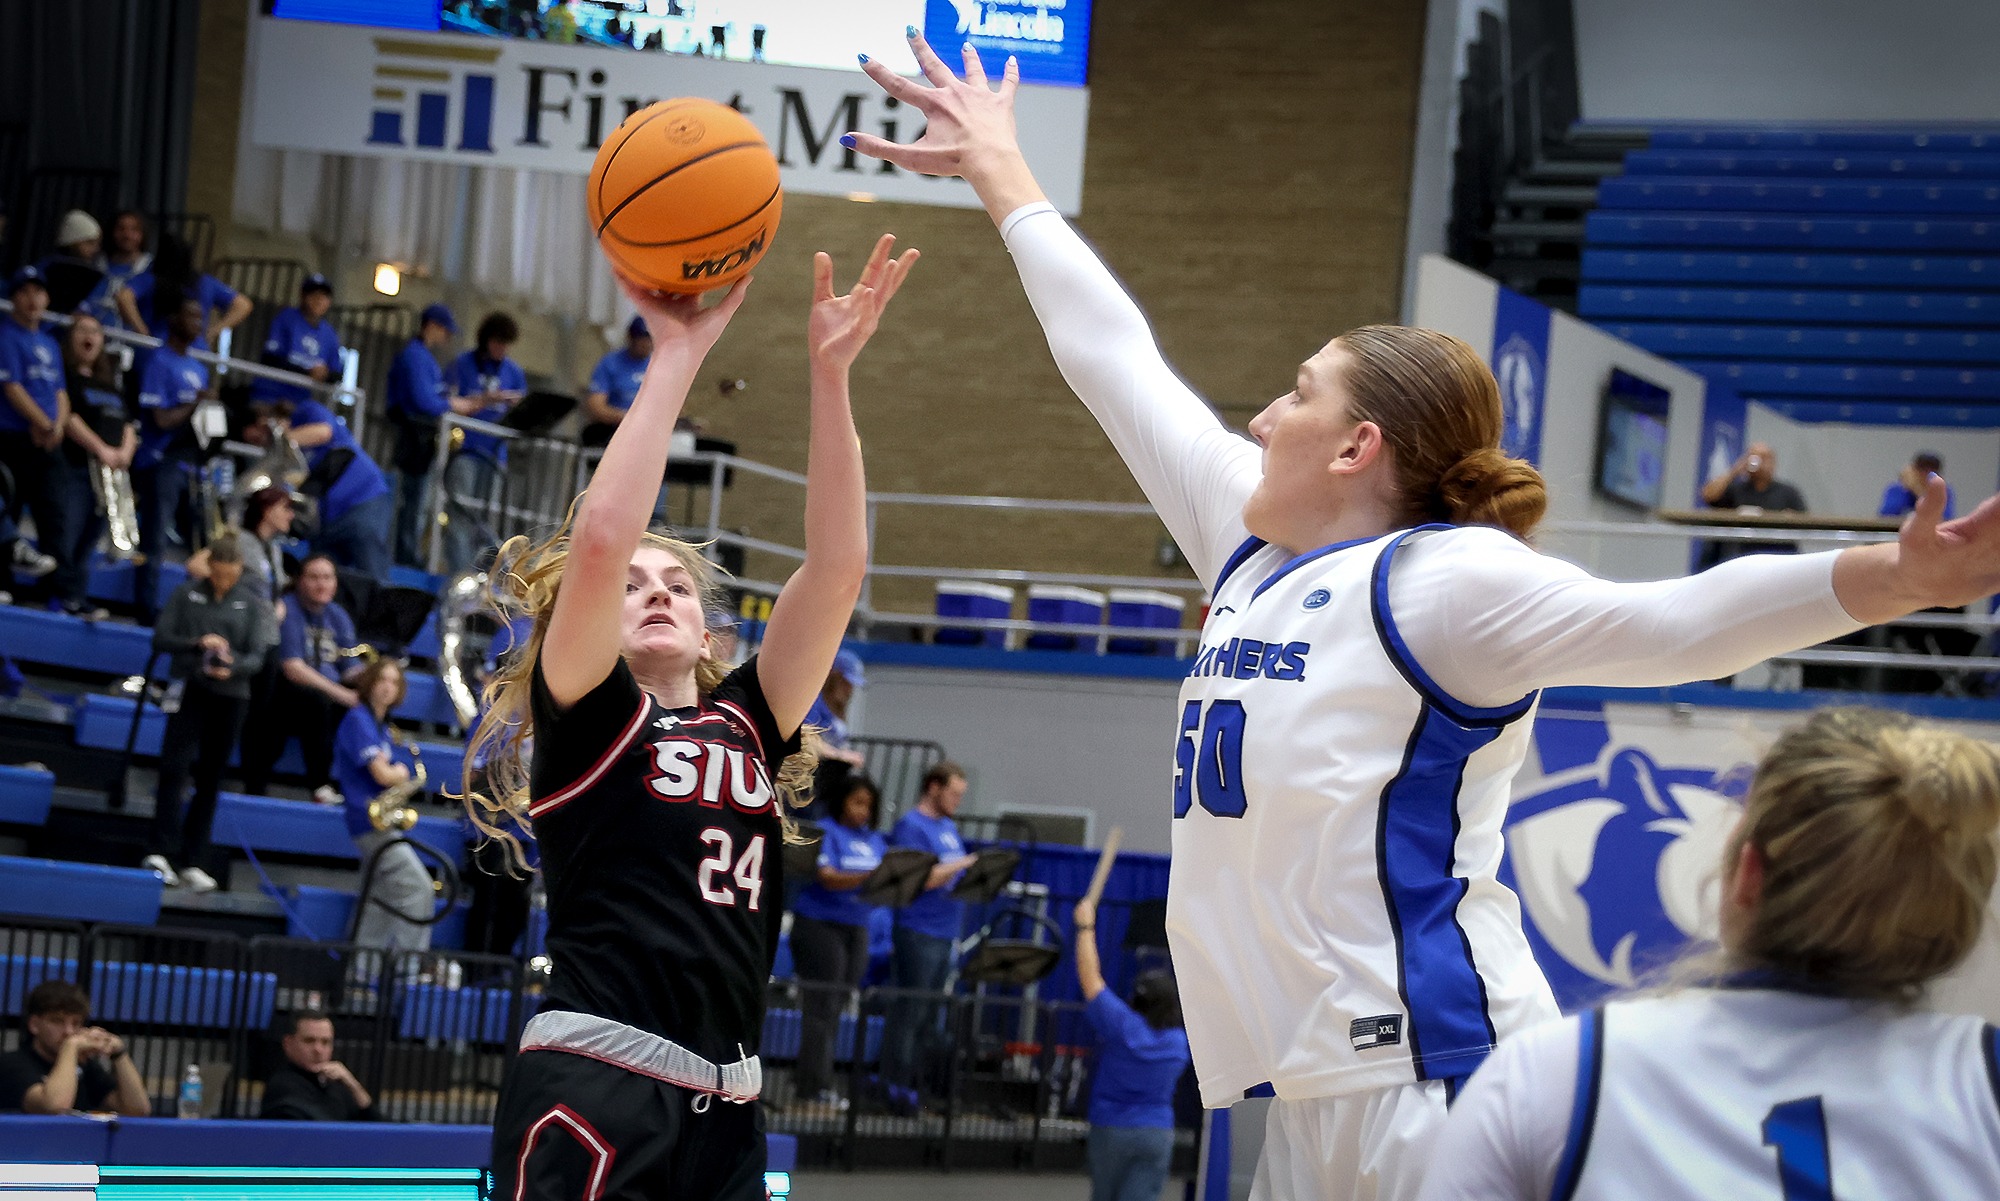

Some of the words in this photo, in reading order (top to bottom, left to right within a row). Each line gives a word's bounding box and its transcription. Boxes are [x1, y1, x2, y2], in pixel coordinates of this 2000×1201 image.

[968, 2, 1065, 42] Lincoln
[774, 84, 967, 182] Mi
[682, 224, 767, 280] NCAA
[647, 738, 782, 817] SIU
[1173, 698, 1249, 818] 50
[698, 826, 766, 912] 24
[1378, 1024, 1396, 1035] XXL
[1762, 1094, 1835, 1201] 1
